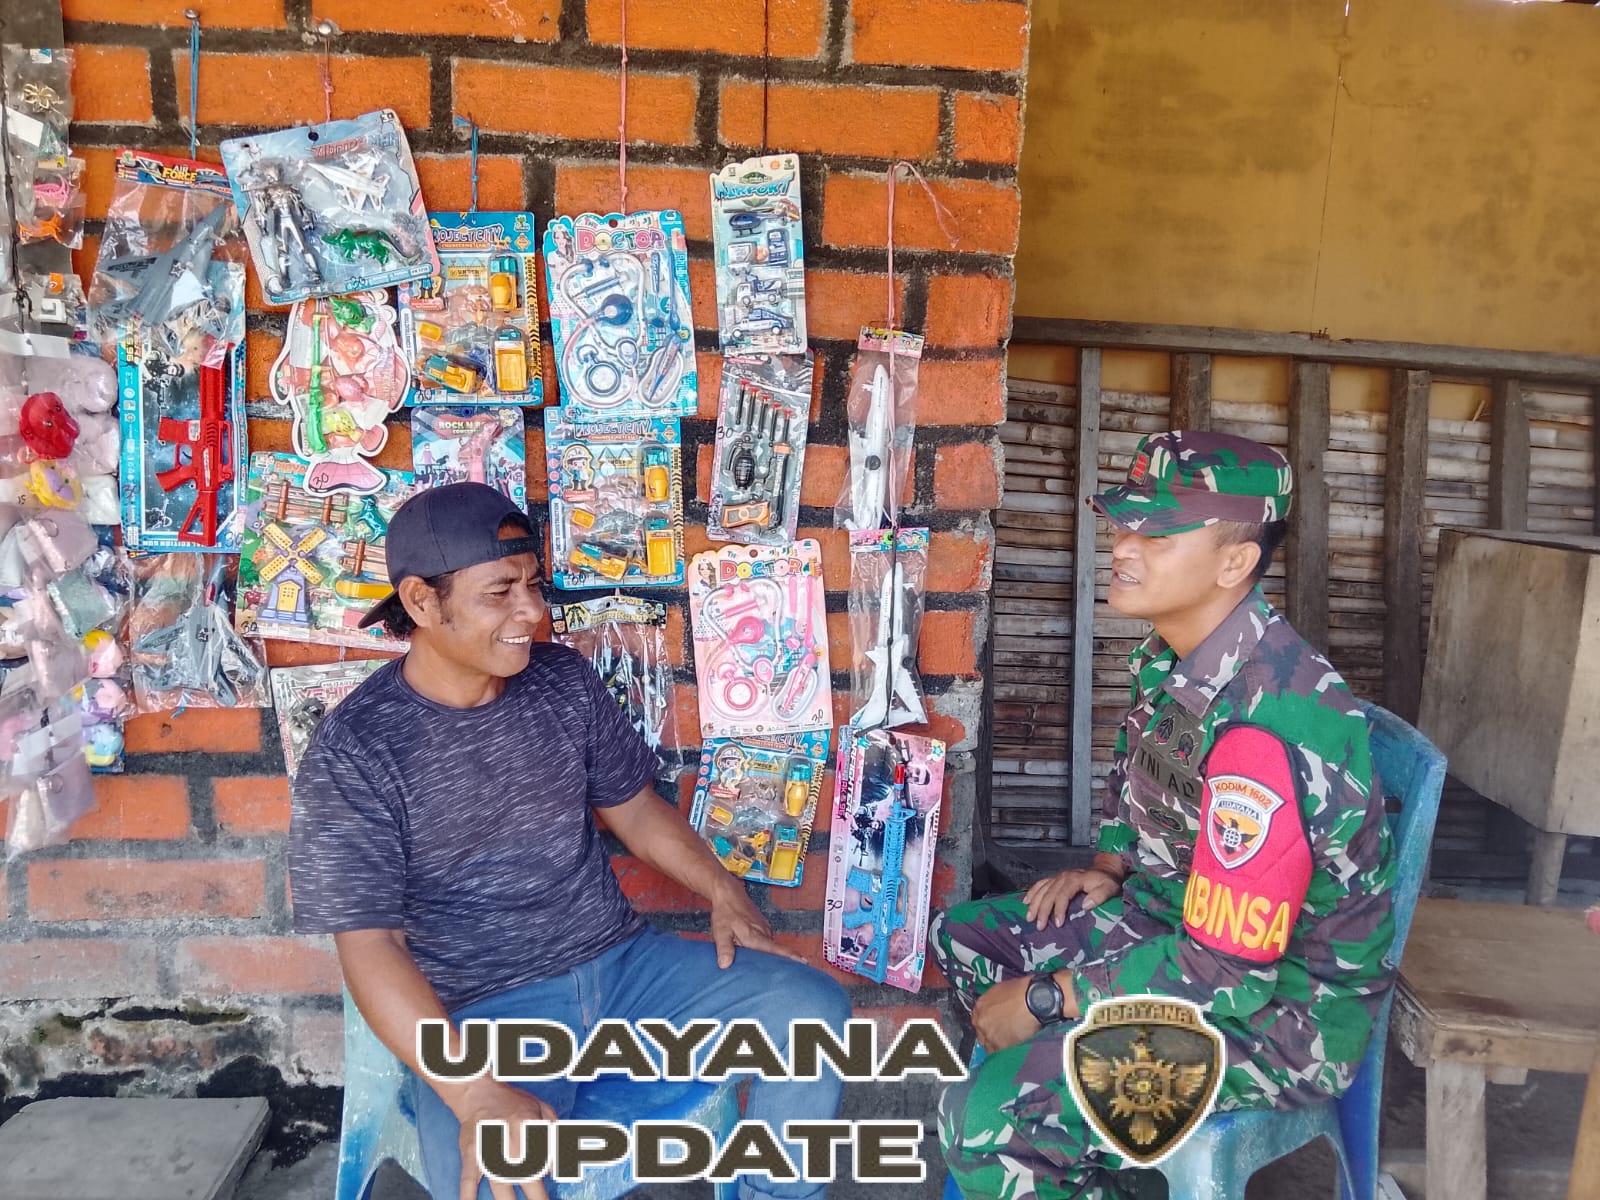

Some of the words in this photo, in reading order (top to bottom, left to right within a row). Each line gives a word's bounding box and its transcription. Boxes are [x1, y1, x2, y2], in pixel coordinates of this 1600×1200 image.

[162, 168, 197, 181] FORCE
[173, 164, 189, 173] AIR
[577, 229, 665, 252] DOCTOR
[438, 421, 463, 429] ROCK
[716, 426, 735, 440] 30
[313, 472, 330, 489] 30
[720, 557, 802, 582] DOCTOR
[811, 709, 825, 725] 30
[1141, 747, 1160, 780] TNI
[1168, 773, 1195, 799] AD
[1214, 782, 1248, 794] KODIM
[1249, 788, 1272, 809] 1602
[1219, 801, 1260, 820] UDAYANA
[827, 898, 844, 912] 30
